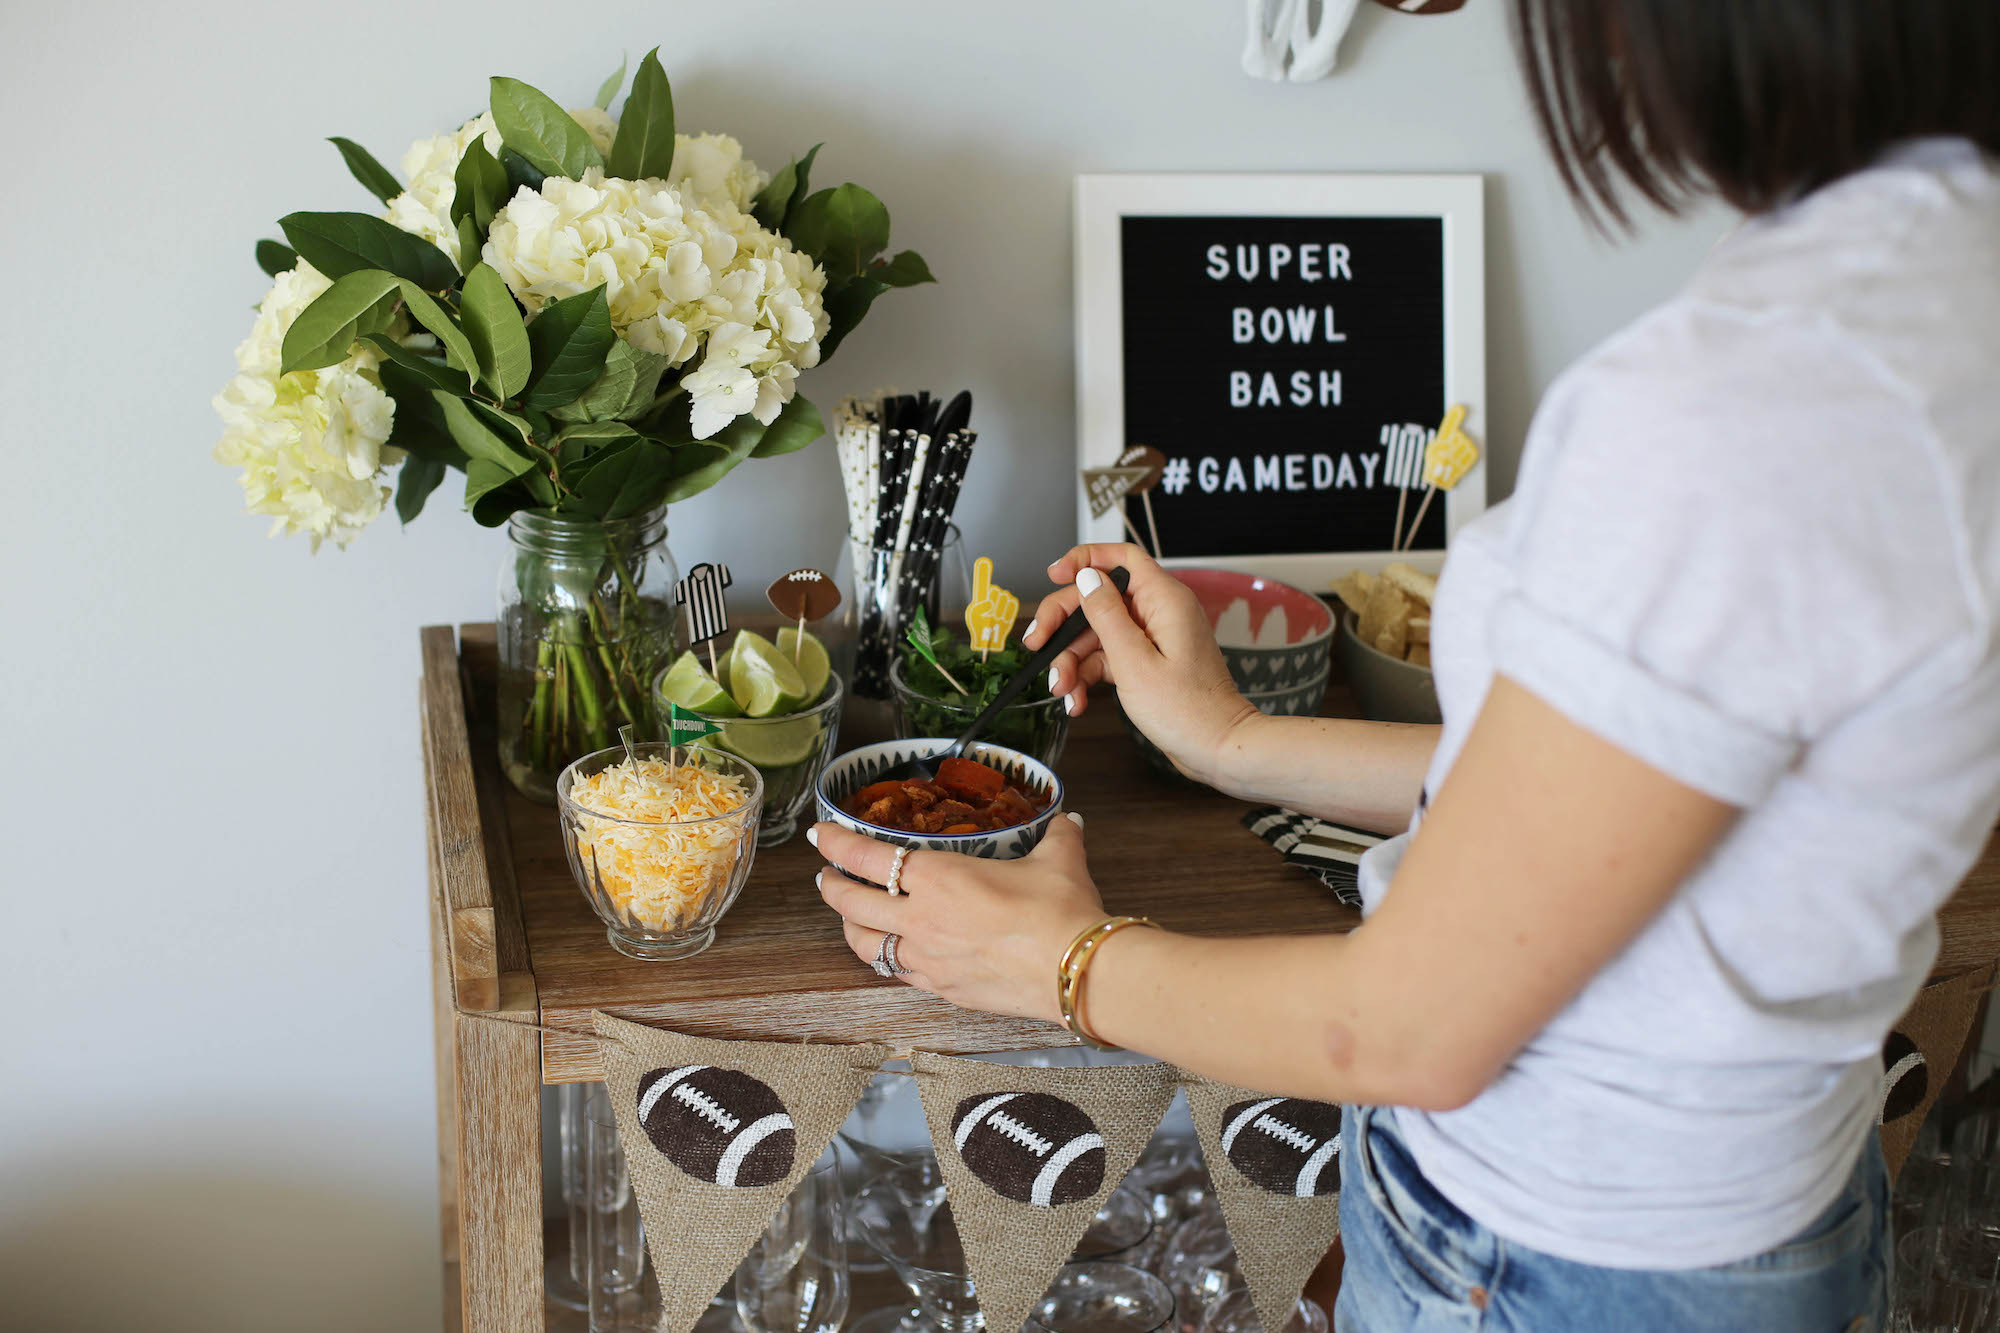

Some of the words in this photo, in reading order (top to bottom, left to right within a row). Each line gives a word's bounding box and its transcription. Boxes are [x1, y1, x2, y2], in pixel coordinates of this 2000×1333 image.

[1206, 243, 1353, 282] SUPER
[1232, 304, 1347, 343] BOWL
[1230, 370, 1342, 407] BASH
[1162, 453, 1380, 494] #GAMEDAY
[980, 624, 1001, 644] #1
